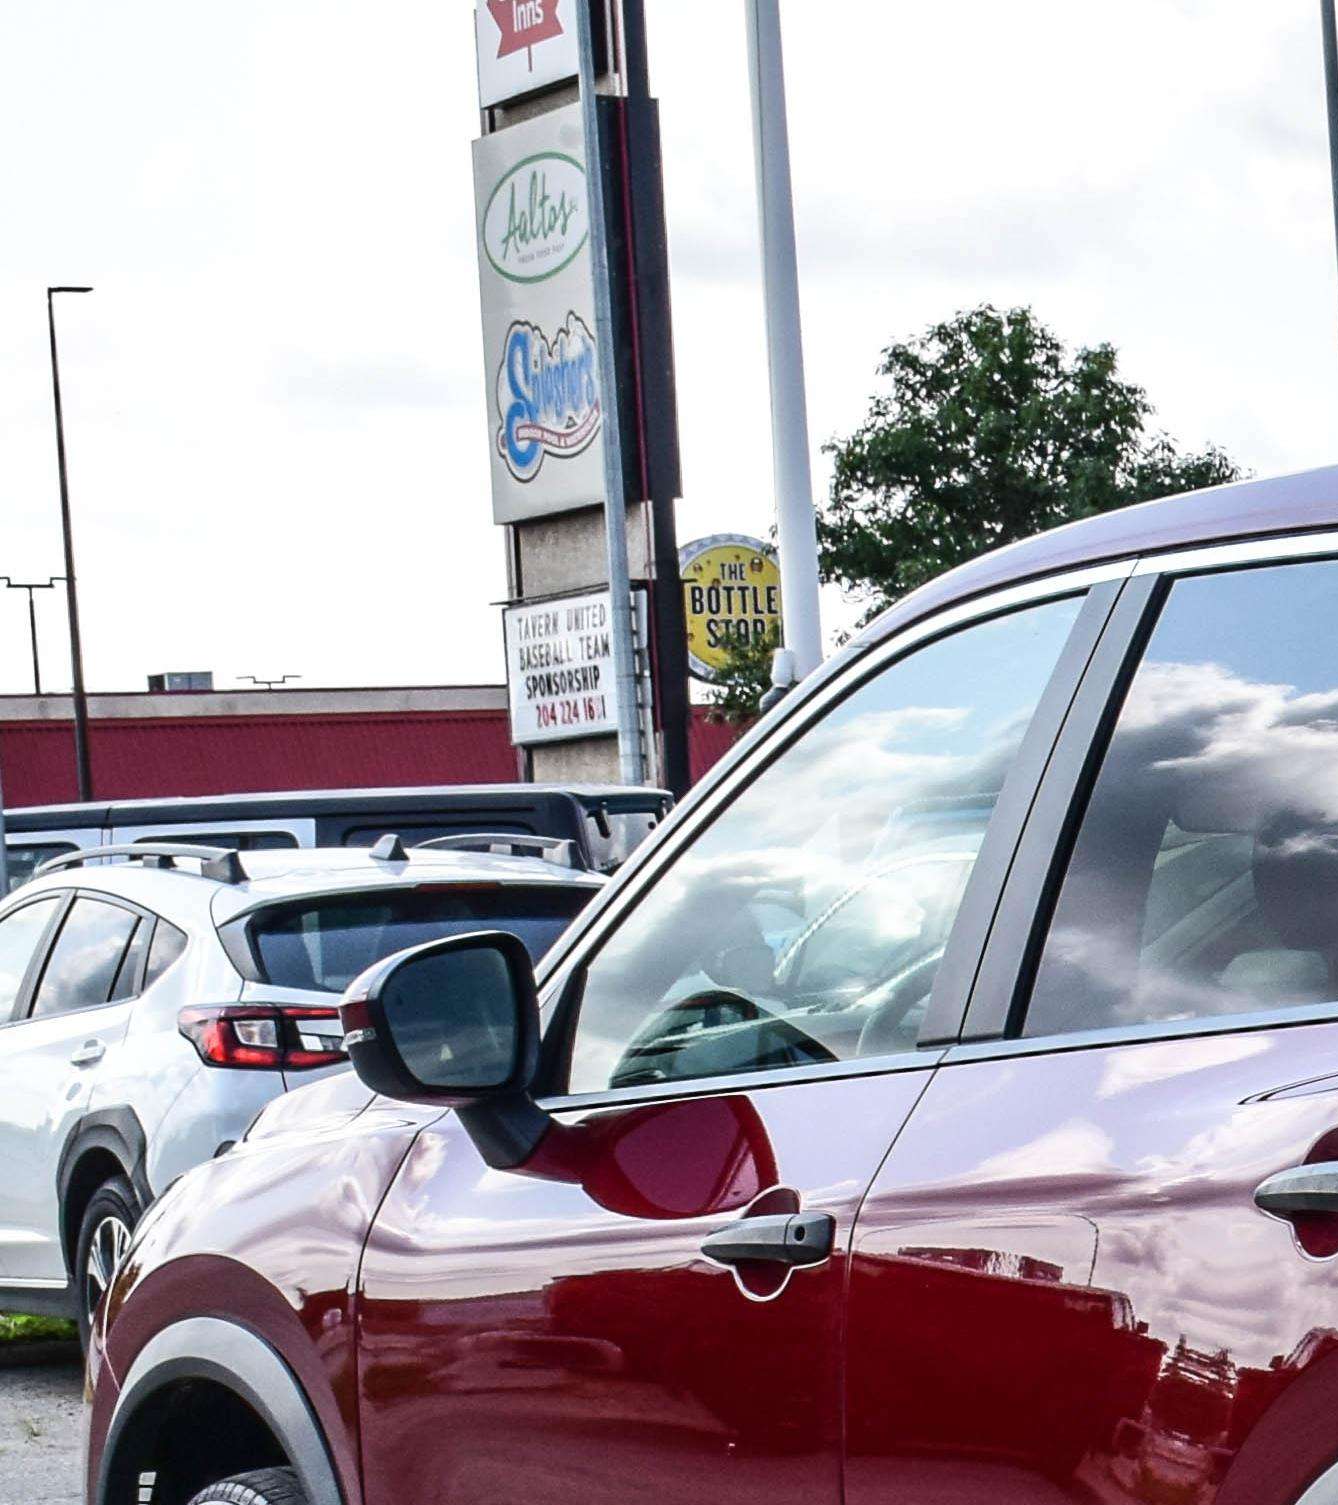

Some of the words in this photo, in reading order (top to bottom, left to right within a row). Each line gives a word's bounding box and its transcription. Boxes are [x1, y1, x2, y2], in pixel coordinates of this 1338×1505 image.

[512, 0, 544, 33] Inns
[720, 563, 746, 580] THE
[691, 585, 778, 615] BOTTLE
[518, 612, 559, 641] TAVERN
[566, 604, 606, 632] UNITED
[519, 640, 574, 671] BASEBALL
[579, 632, 611, 660] TEAM
[526, 665, 600, 699] SPONSORSHIP
[583, 694, 606, 720] 161
